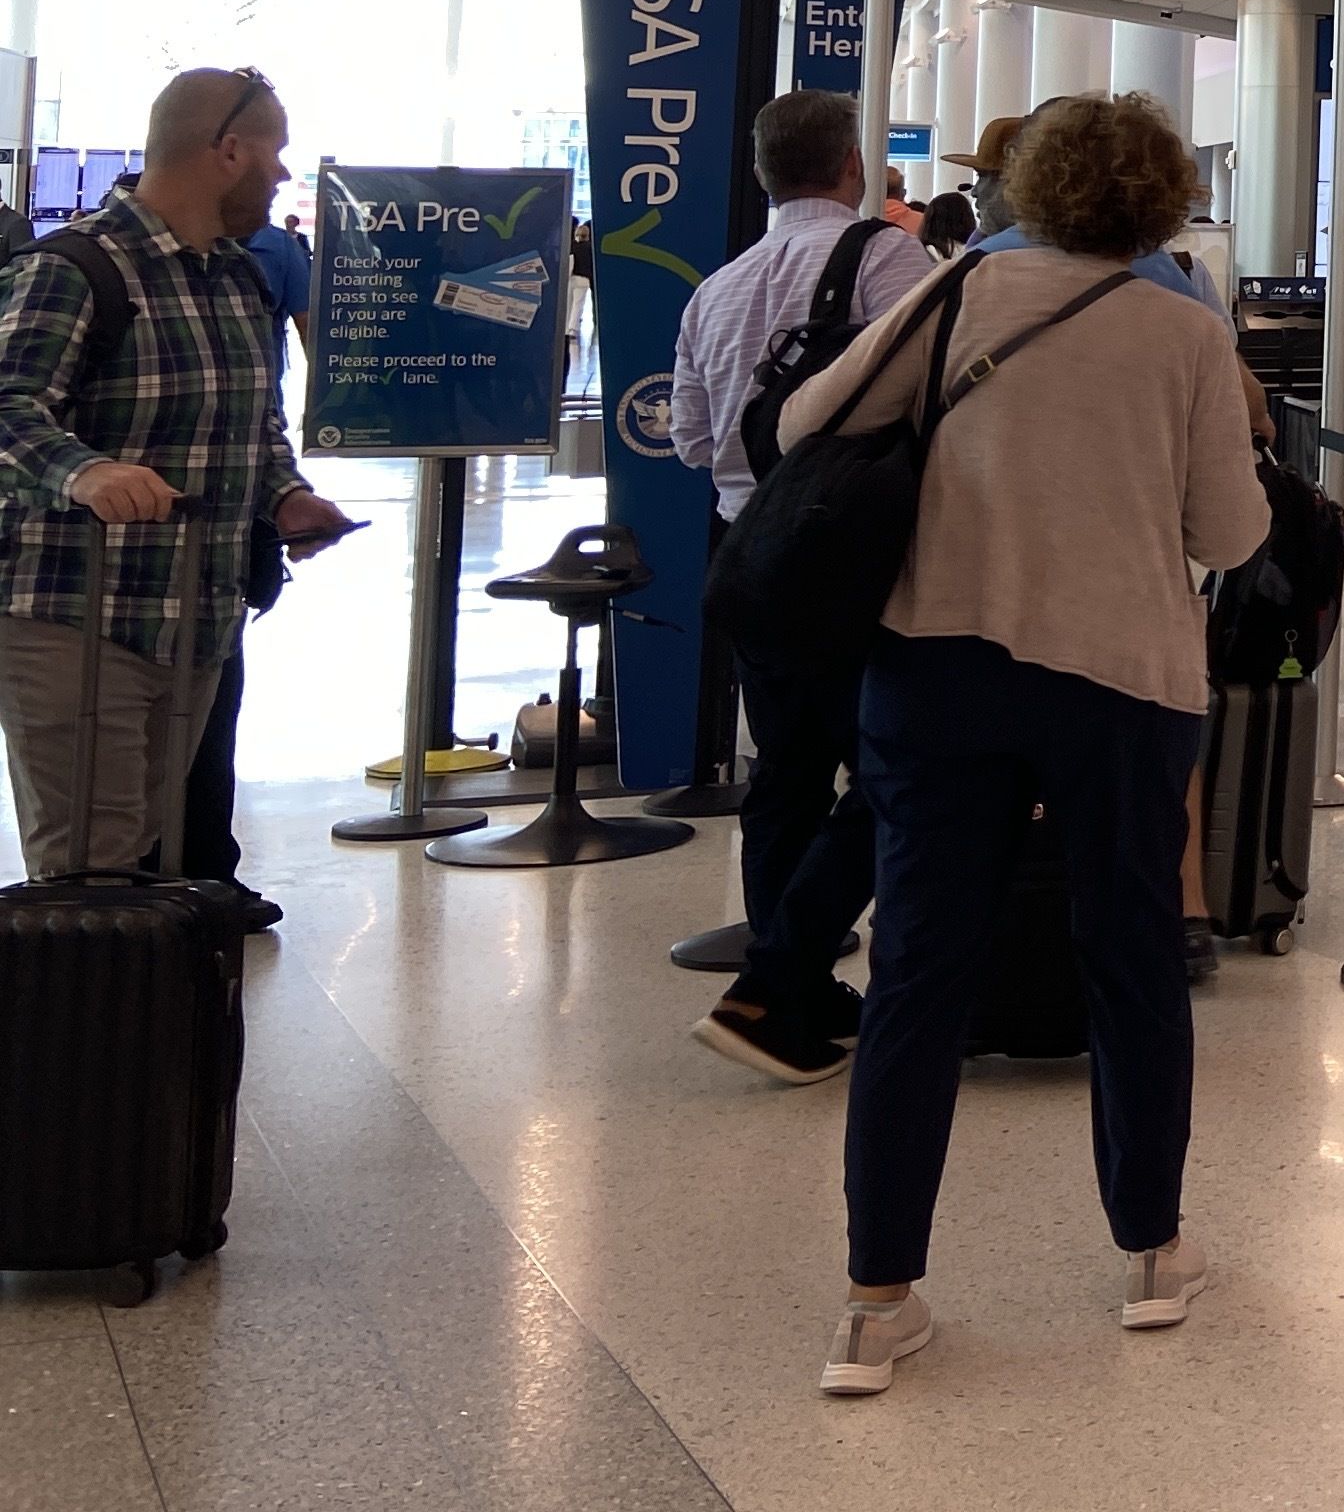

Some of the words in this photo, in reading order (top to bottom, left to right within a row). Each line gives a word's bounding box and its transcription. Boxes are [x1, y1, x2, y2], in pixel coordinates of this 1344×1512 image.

[805, 0, 865, 27] Ent
[808, 30, 864, 58] Her
[620, 88, 699, 206] Pre
[332, 200, 407, 233] TSA
[416, 201, 481, 233] Pre
[333, 255, 381, 270] Check
[385, 257, 422, 273] your
[333, 273, 403, 290] boarding
[331, 292, 367, 306] pass
[371, 291, 388, 304] to
[391, 292, 418, 304] see
[331, 307, 344, 321] if
[347, 309, 377, 324] you
[380, 309, 407, 321] are
[329, 324, 390, 340] eligible.
[328, 354, 379, 367] Please
[383, 354, 446, 369] proceed
[450, 354, 466, 367] to
[471, 353, 497, 367] the
[327, 372, 352, 384] TSA
[355, 372, 379, 384] Pre
[402, 371, 440, 385] lane.
